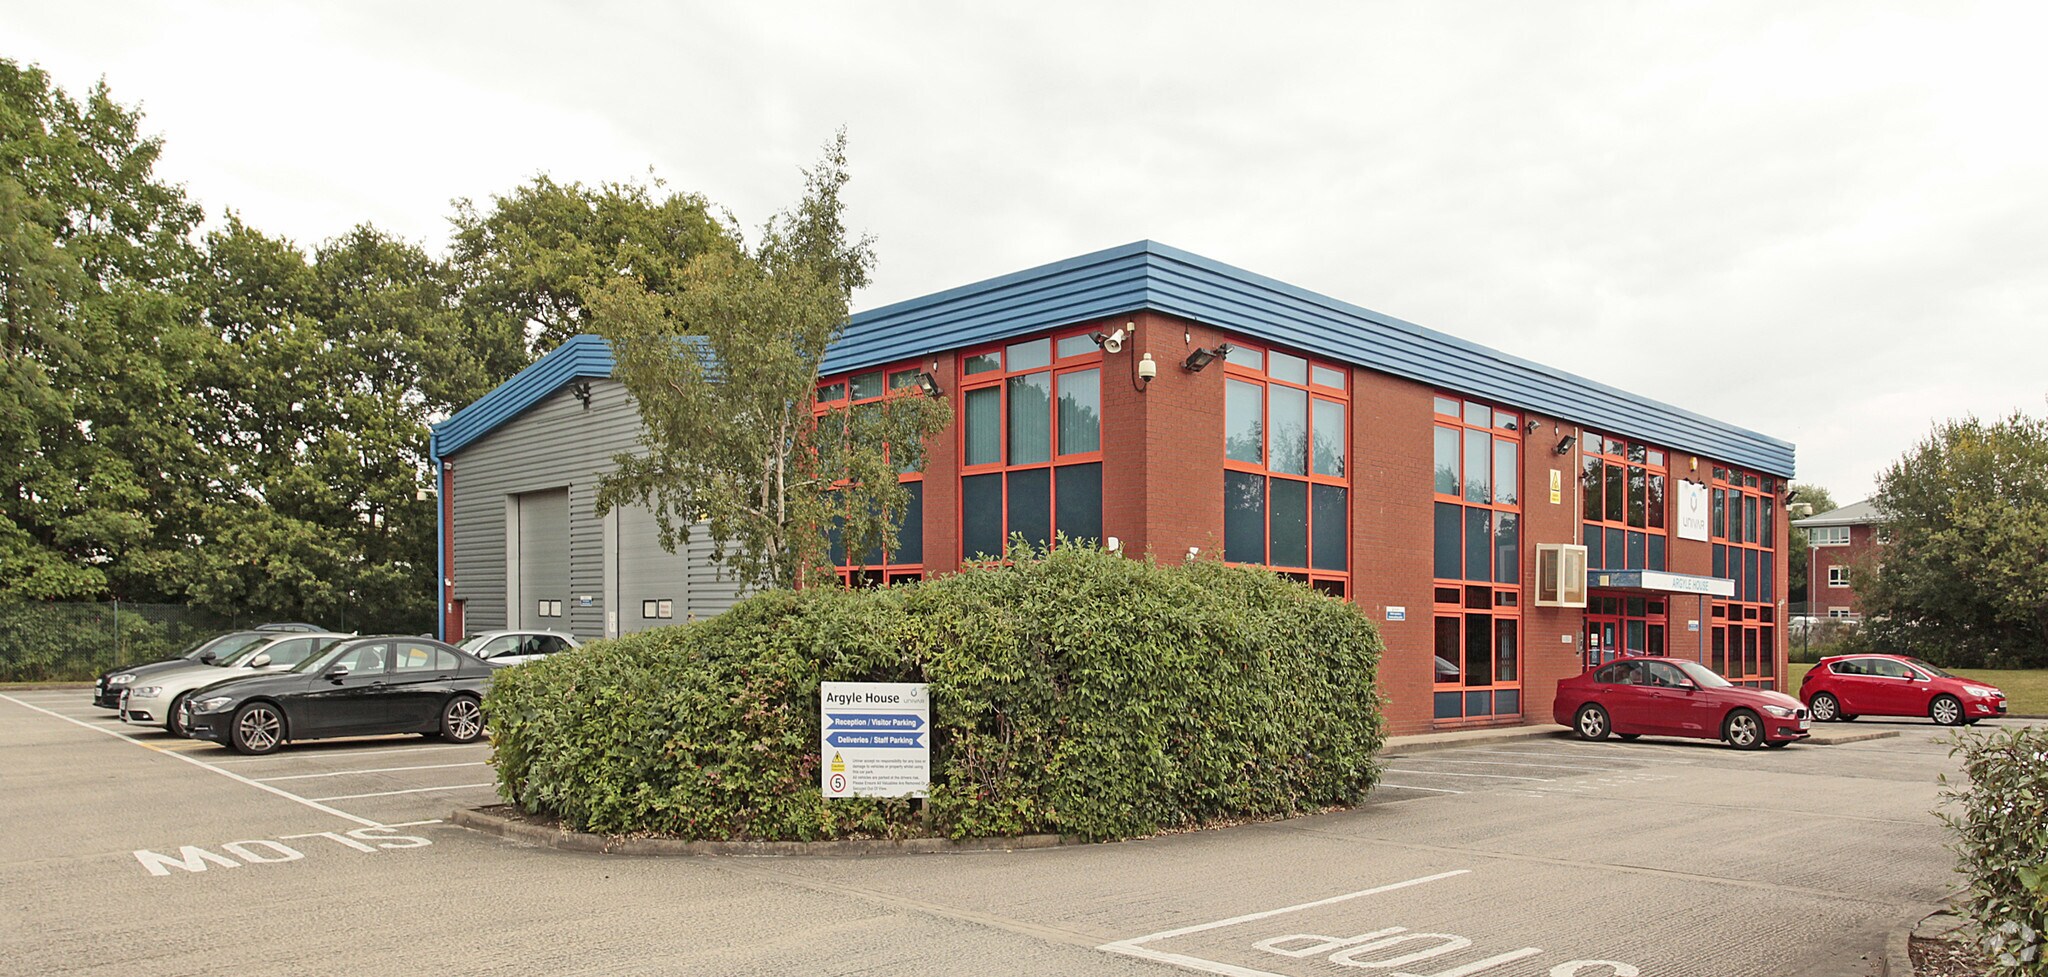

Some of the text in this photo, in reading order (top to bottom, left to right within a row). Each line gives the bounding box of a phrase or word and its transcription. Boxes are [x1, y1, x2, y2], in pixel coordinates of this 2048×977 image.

[1672, 578, 1708, 591] ARGYLE HOUSE
[826, 692, 899, 705] Argyle House
[835, 718, 866, 727] Reception
[871, 718, 892, 726] Visitor
[892, 719, 916, 728] Parking
[838, 736, 869, 744] Deliveries
[873, 736, 889, 744] Staff
[890, 737, 914, 746] Parking
[835, 777, 842, 789] 5
[133, 826, 433, 876] SLOW
